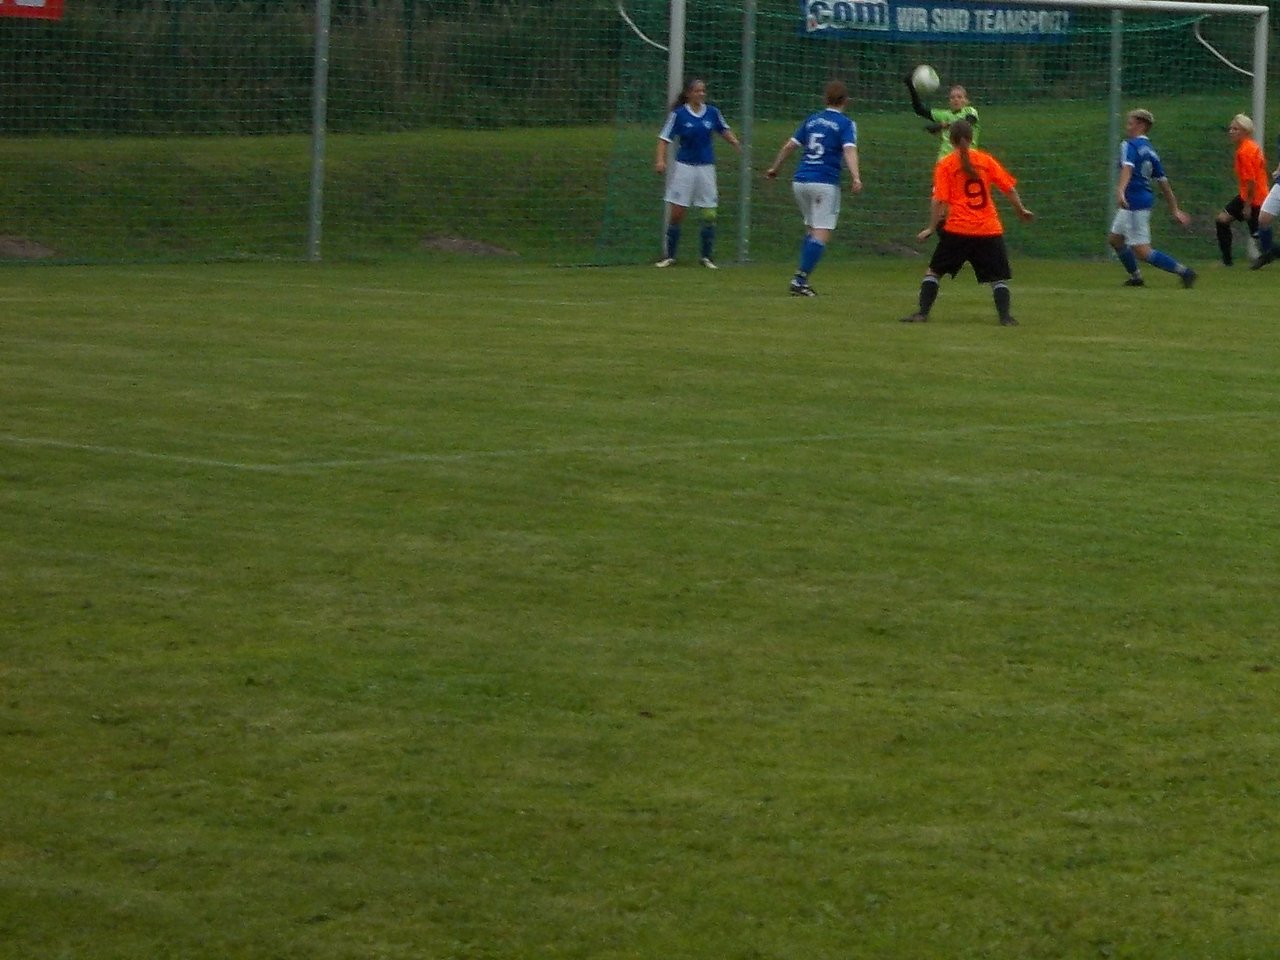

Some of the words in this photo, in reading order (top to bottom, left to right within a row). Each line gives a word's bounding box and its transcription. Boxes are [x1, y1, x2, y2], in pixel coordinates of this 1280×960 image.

[931, 8, 970, 33] SIND
[806, 133, 825, 159] 5
[964, 178, 987, 210] 9
